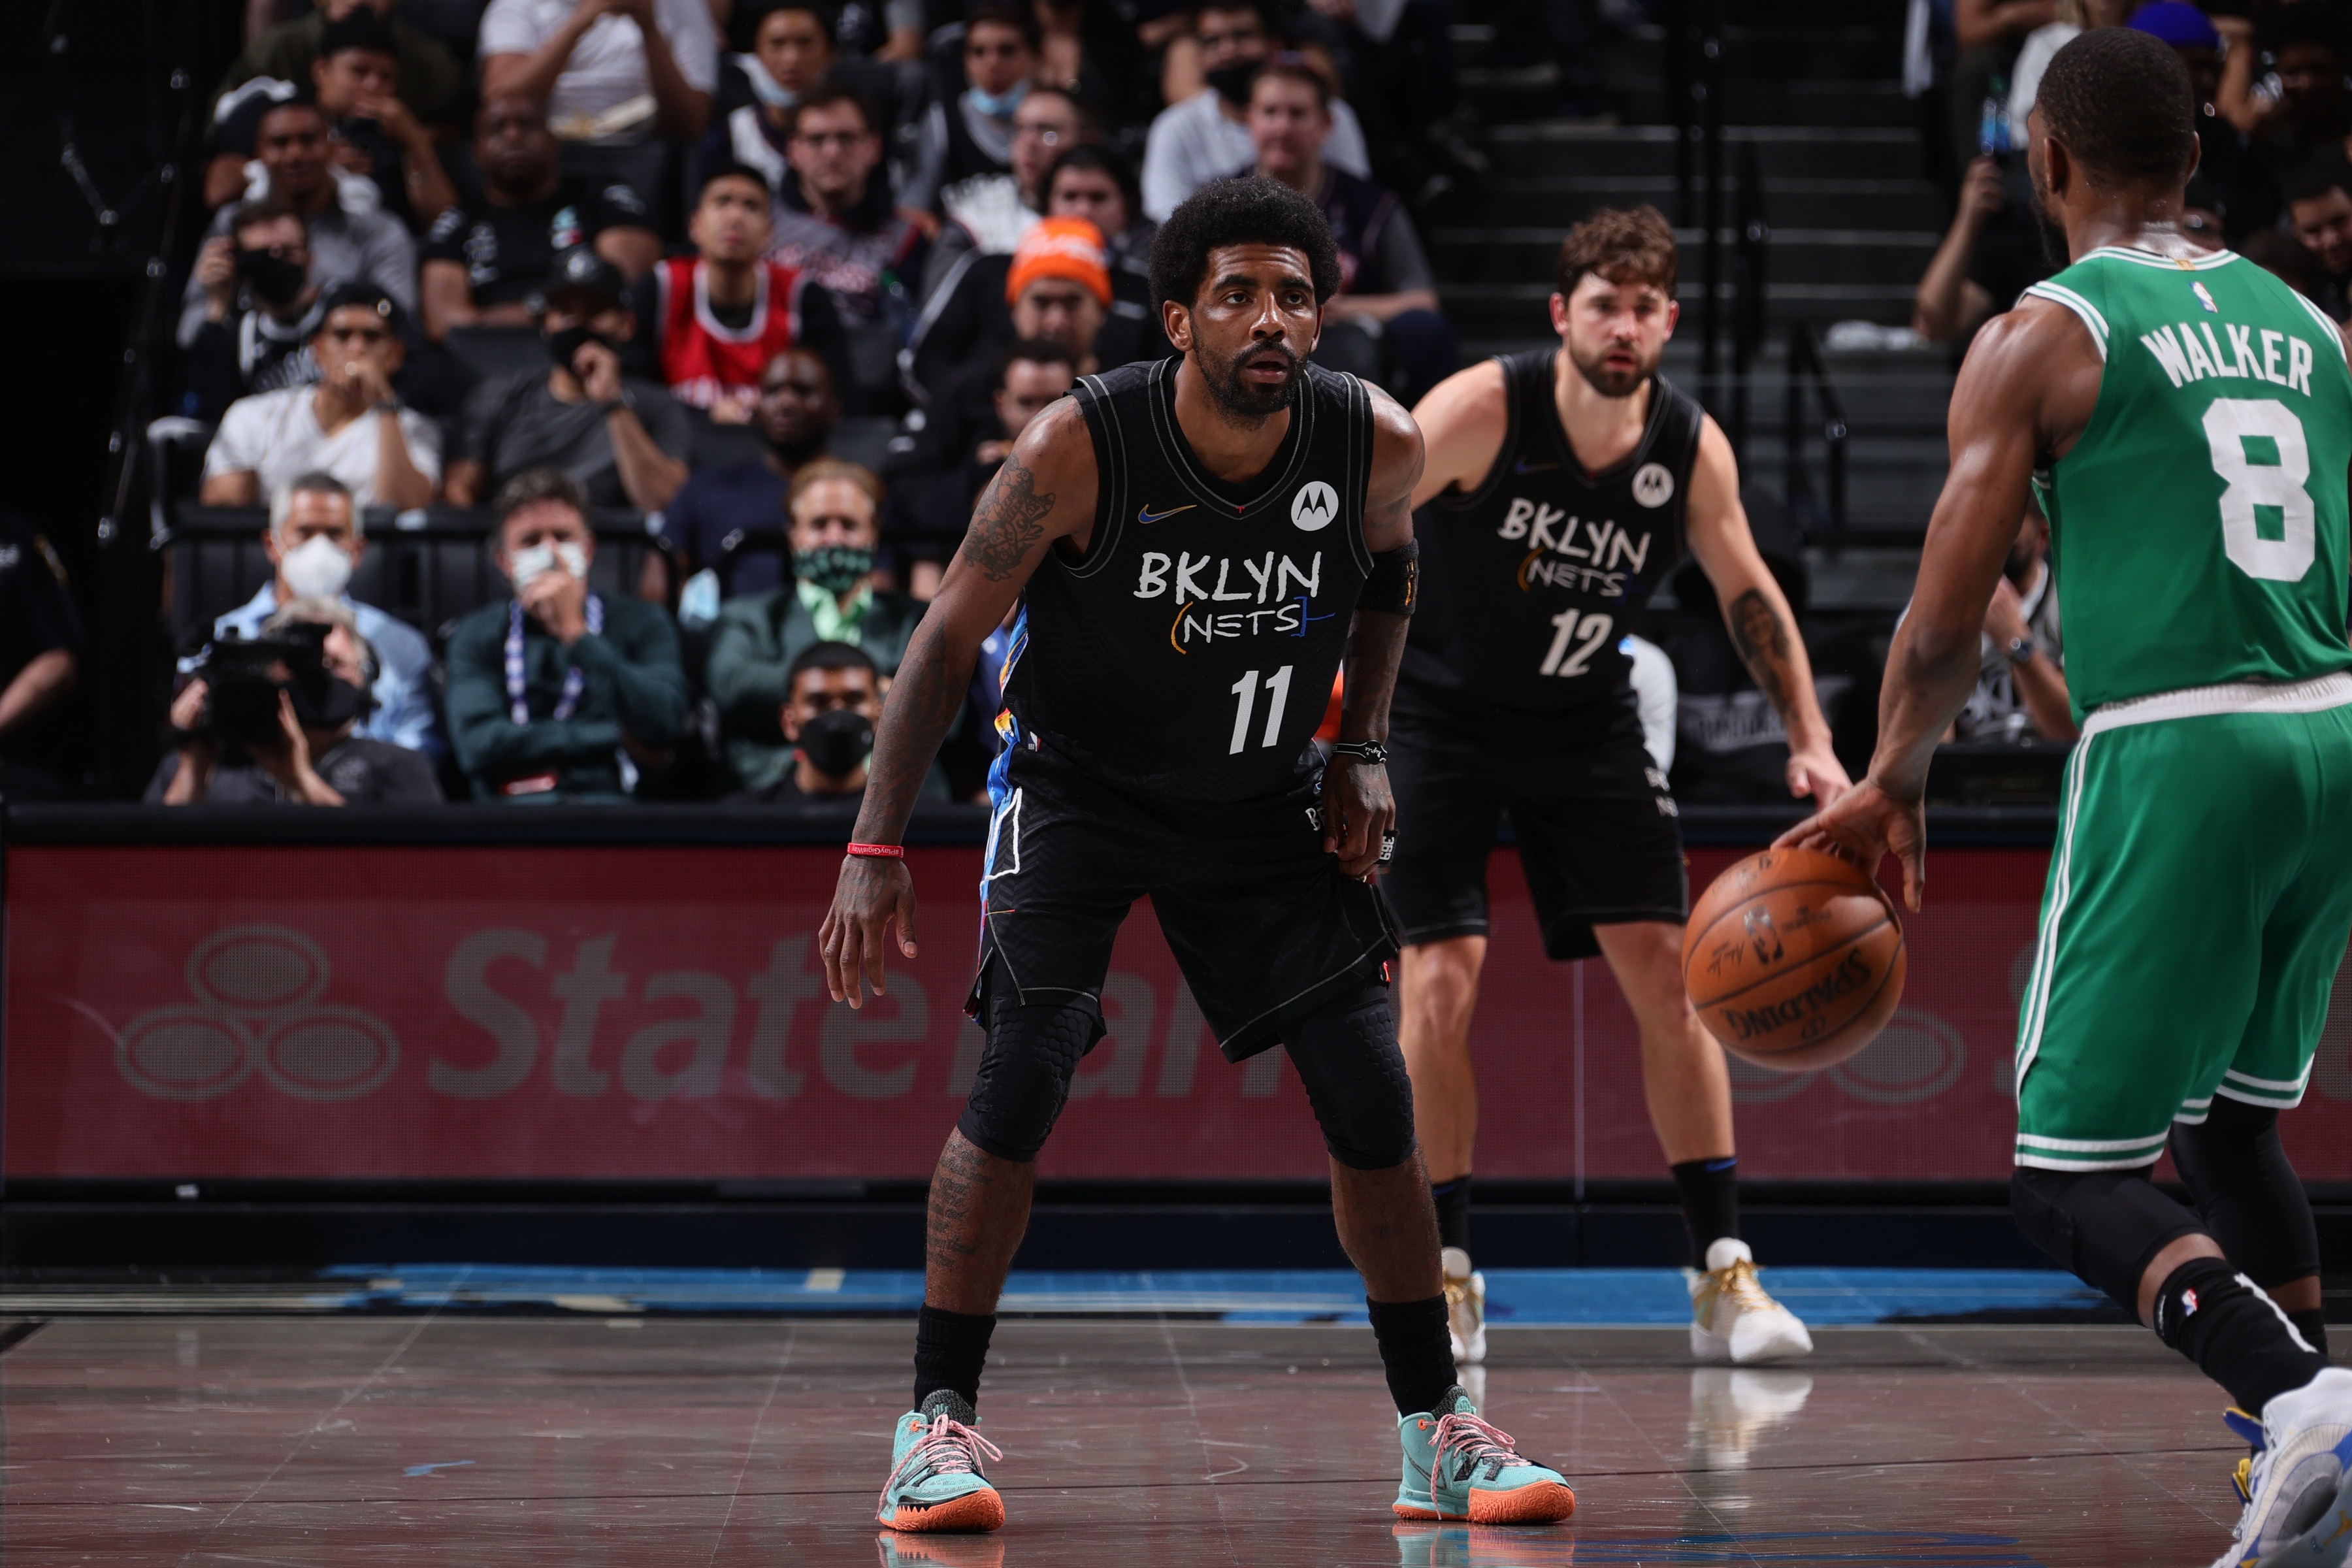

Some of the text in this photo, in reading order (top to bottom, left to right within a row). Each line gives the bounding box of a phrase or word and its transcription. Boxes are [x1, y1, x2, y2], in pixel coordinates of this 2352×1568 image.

[2139, 321, 2313, 398] WALKER
[2201, 397, 2316, 582] 8
[1496, 497, 1652, 575] BKLYN
[1133, 551, 1322, 605] BKLYN
[1183, 603, 1301, 644] NETS
[1538, 607, 1614, 678] 12
[1228, 664, 1294, 755] 11
[1719, 945, 1872, 1041] SPALDING
